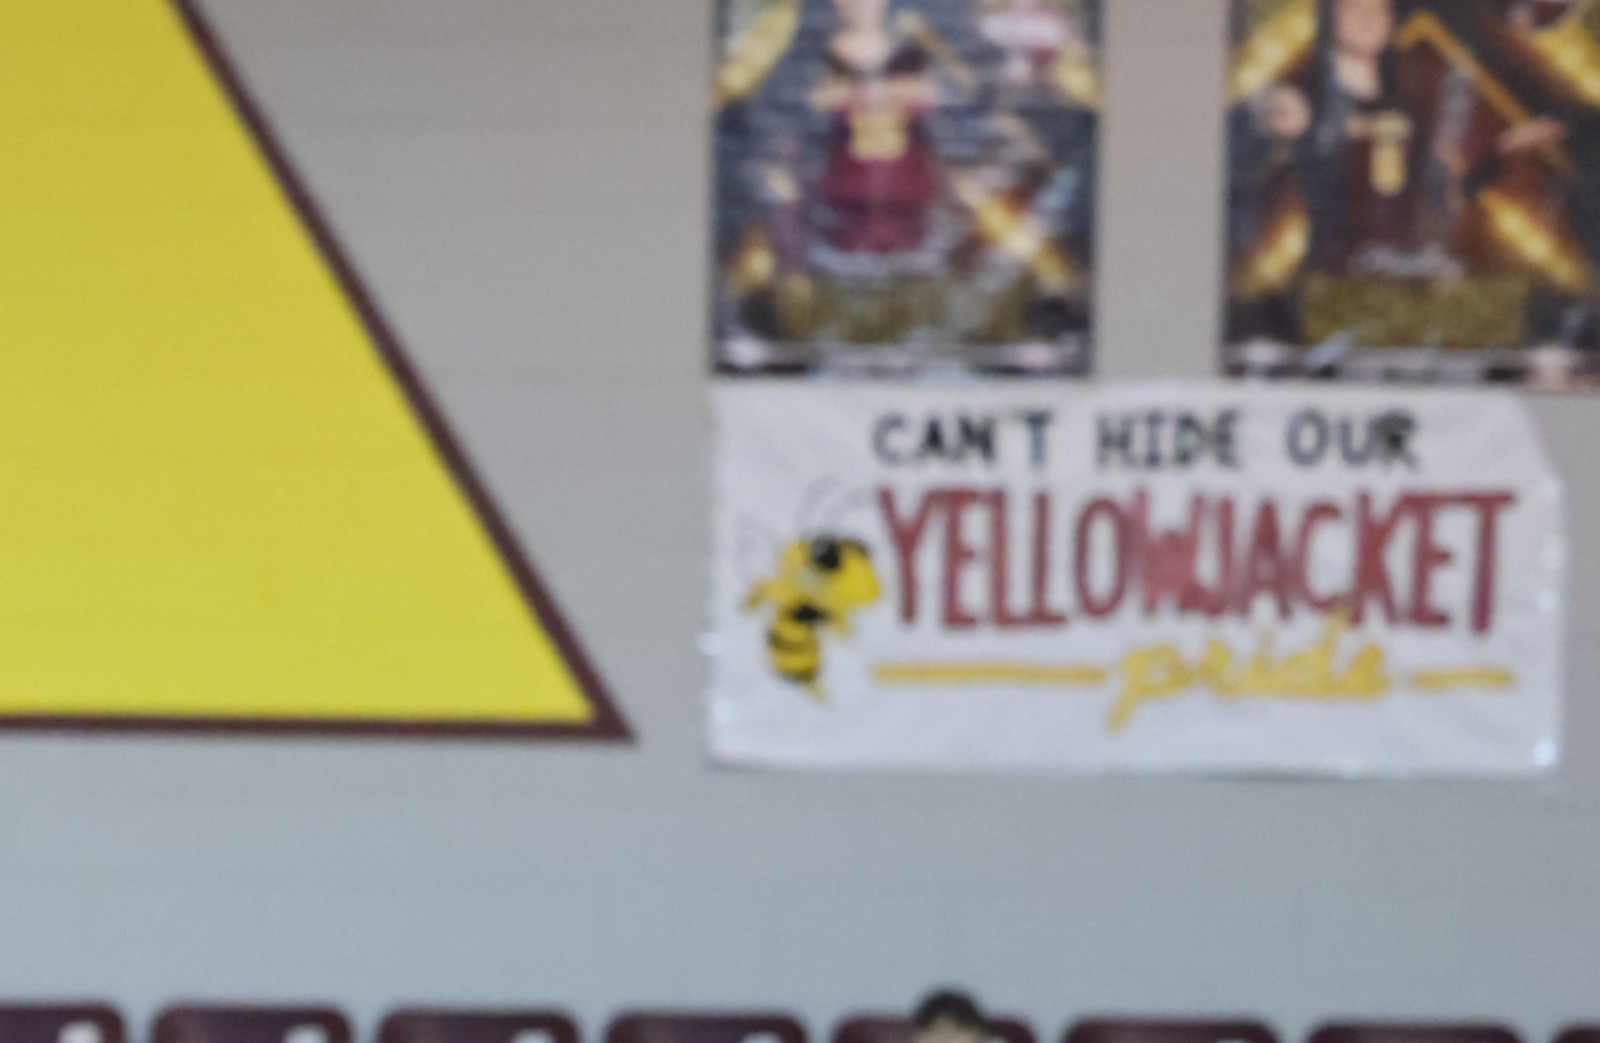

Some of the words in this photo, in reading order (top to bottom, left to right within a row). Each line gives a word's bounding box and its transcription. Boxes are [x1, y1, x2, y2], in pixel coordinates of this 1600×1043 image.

[1095, 410, 1242, 468] HIDE
[1286, 410, 1418, 467] OUR
[1108, 608, 1392, 735] pride
